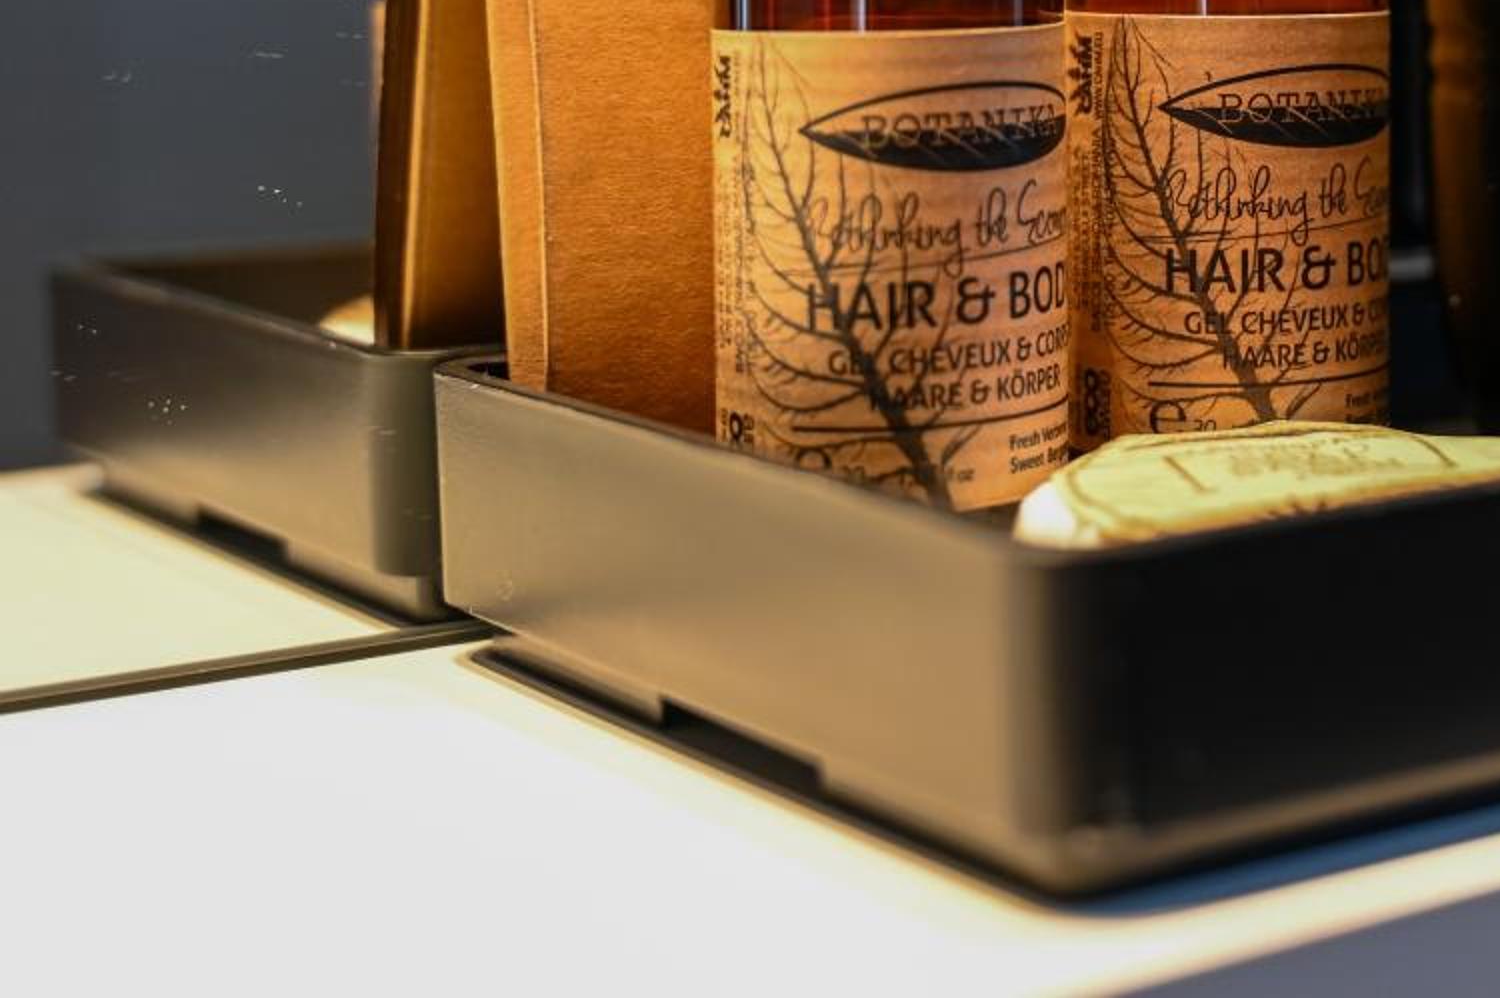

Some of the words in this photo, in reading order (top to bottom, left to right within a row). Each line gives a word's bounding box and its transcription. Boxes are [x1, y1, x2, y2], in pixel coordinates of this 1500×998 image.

[1319, 163, 1346, 218] the
[1165, 248, 1286, 294] HAIR
[1301, 245, 1336, 290] &
[807, 281, 936, 332] HAIR
[956, 276, 995, 325] &
[1241, 305, 1347, 335] CHEVEUX
[1352, 303, 1365, 327] &
[888, 341, 1010, 376] CHEVEUX
[1016, 336, 1031, 361] &
[1313, 340, 1329, 364] &
[970, 379, 990, 404] &
